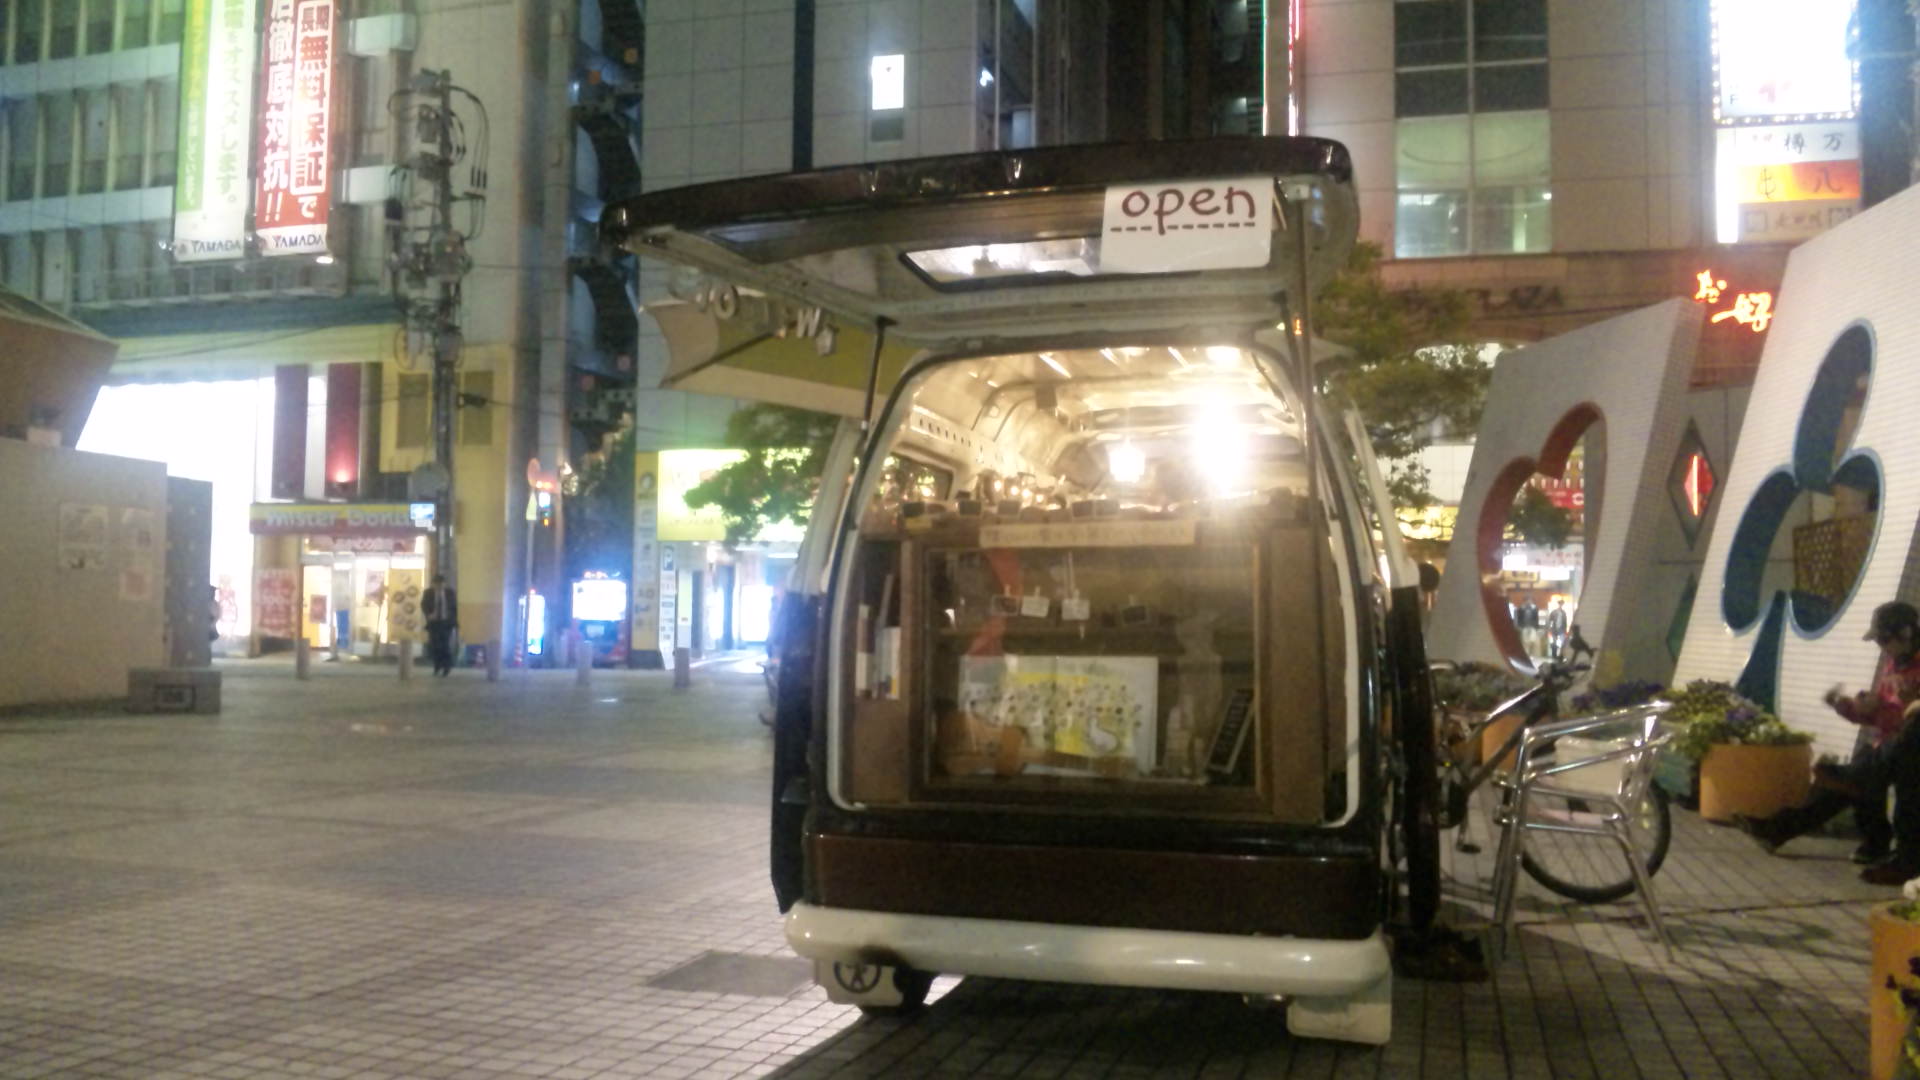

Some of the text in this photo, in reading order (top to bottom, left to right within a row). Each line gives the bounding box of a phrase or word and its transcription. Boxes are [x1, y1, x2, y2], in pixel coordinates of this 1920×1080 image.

[1121, 186, 1256, 236] open
[192, 240, 242, 254] YAMADA
[272, 234, 324, 248] YAMADA
